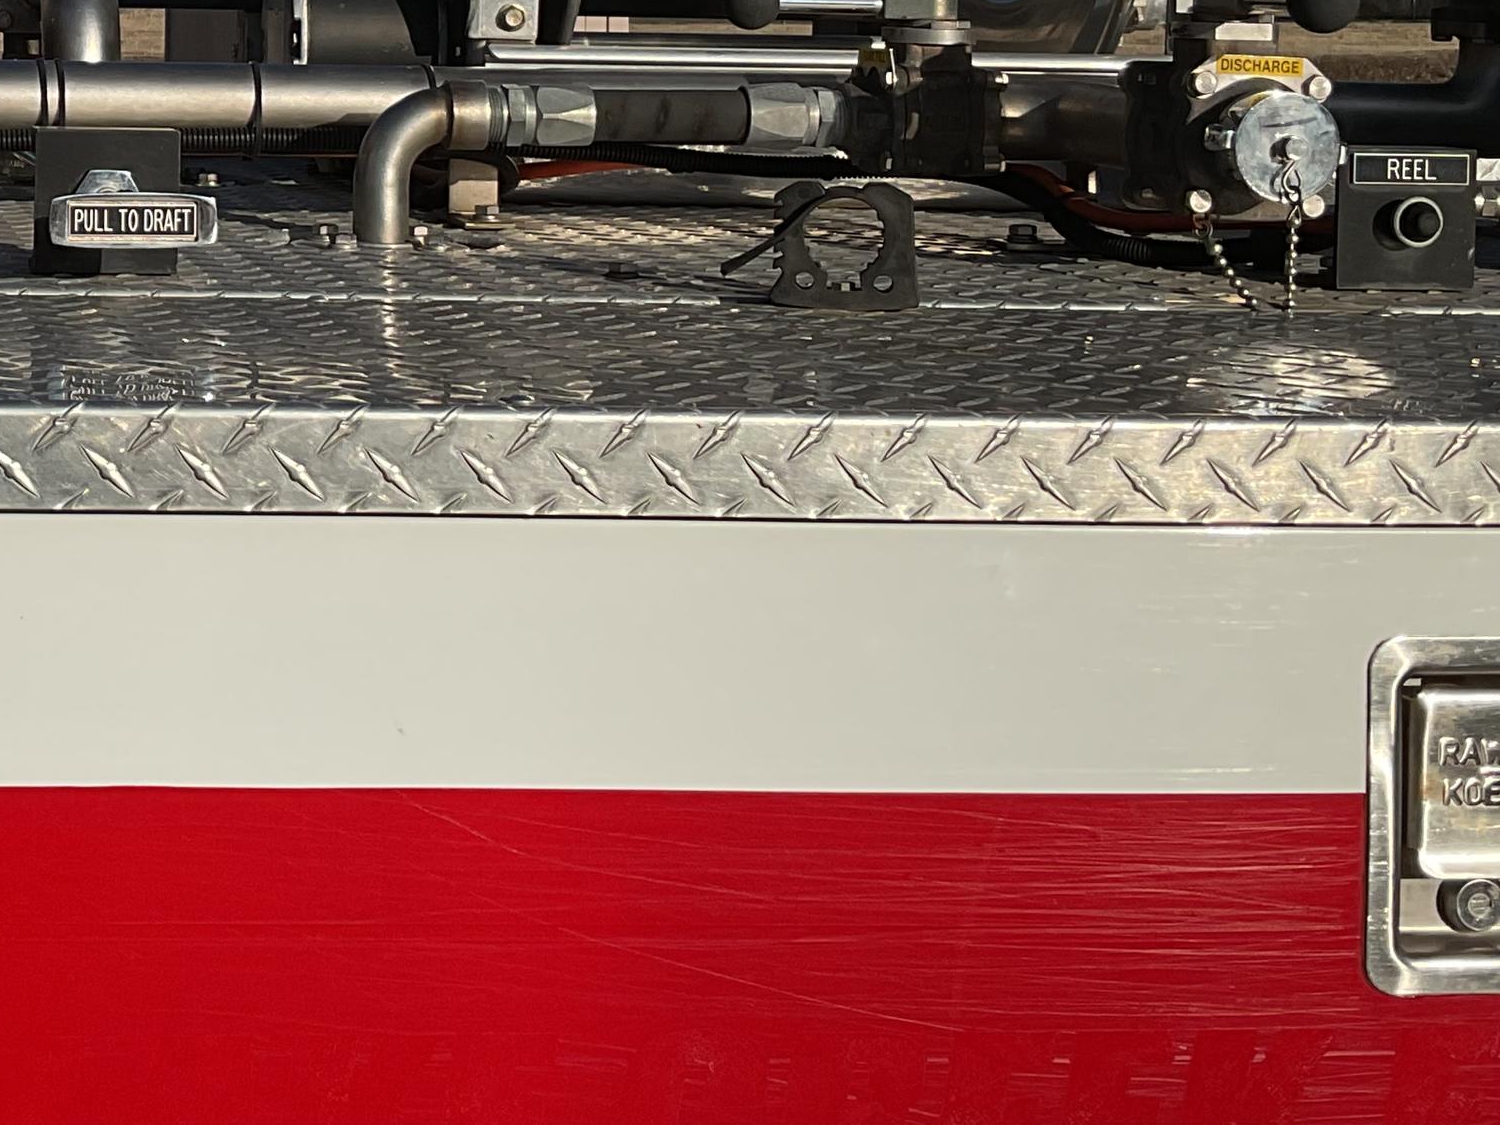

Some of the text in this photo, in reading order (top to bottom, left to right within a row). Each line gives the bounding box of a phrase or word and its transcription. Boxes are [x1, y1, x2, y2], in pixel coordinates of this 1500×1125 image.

[1220, 58, 1300, 74] DISCHARGE
[1387, 158, 1437, 180] REEL
[74, 209, 192, 232] PULL TO DRAFT
